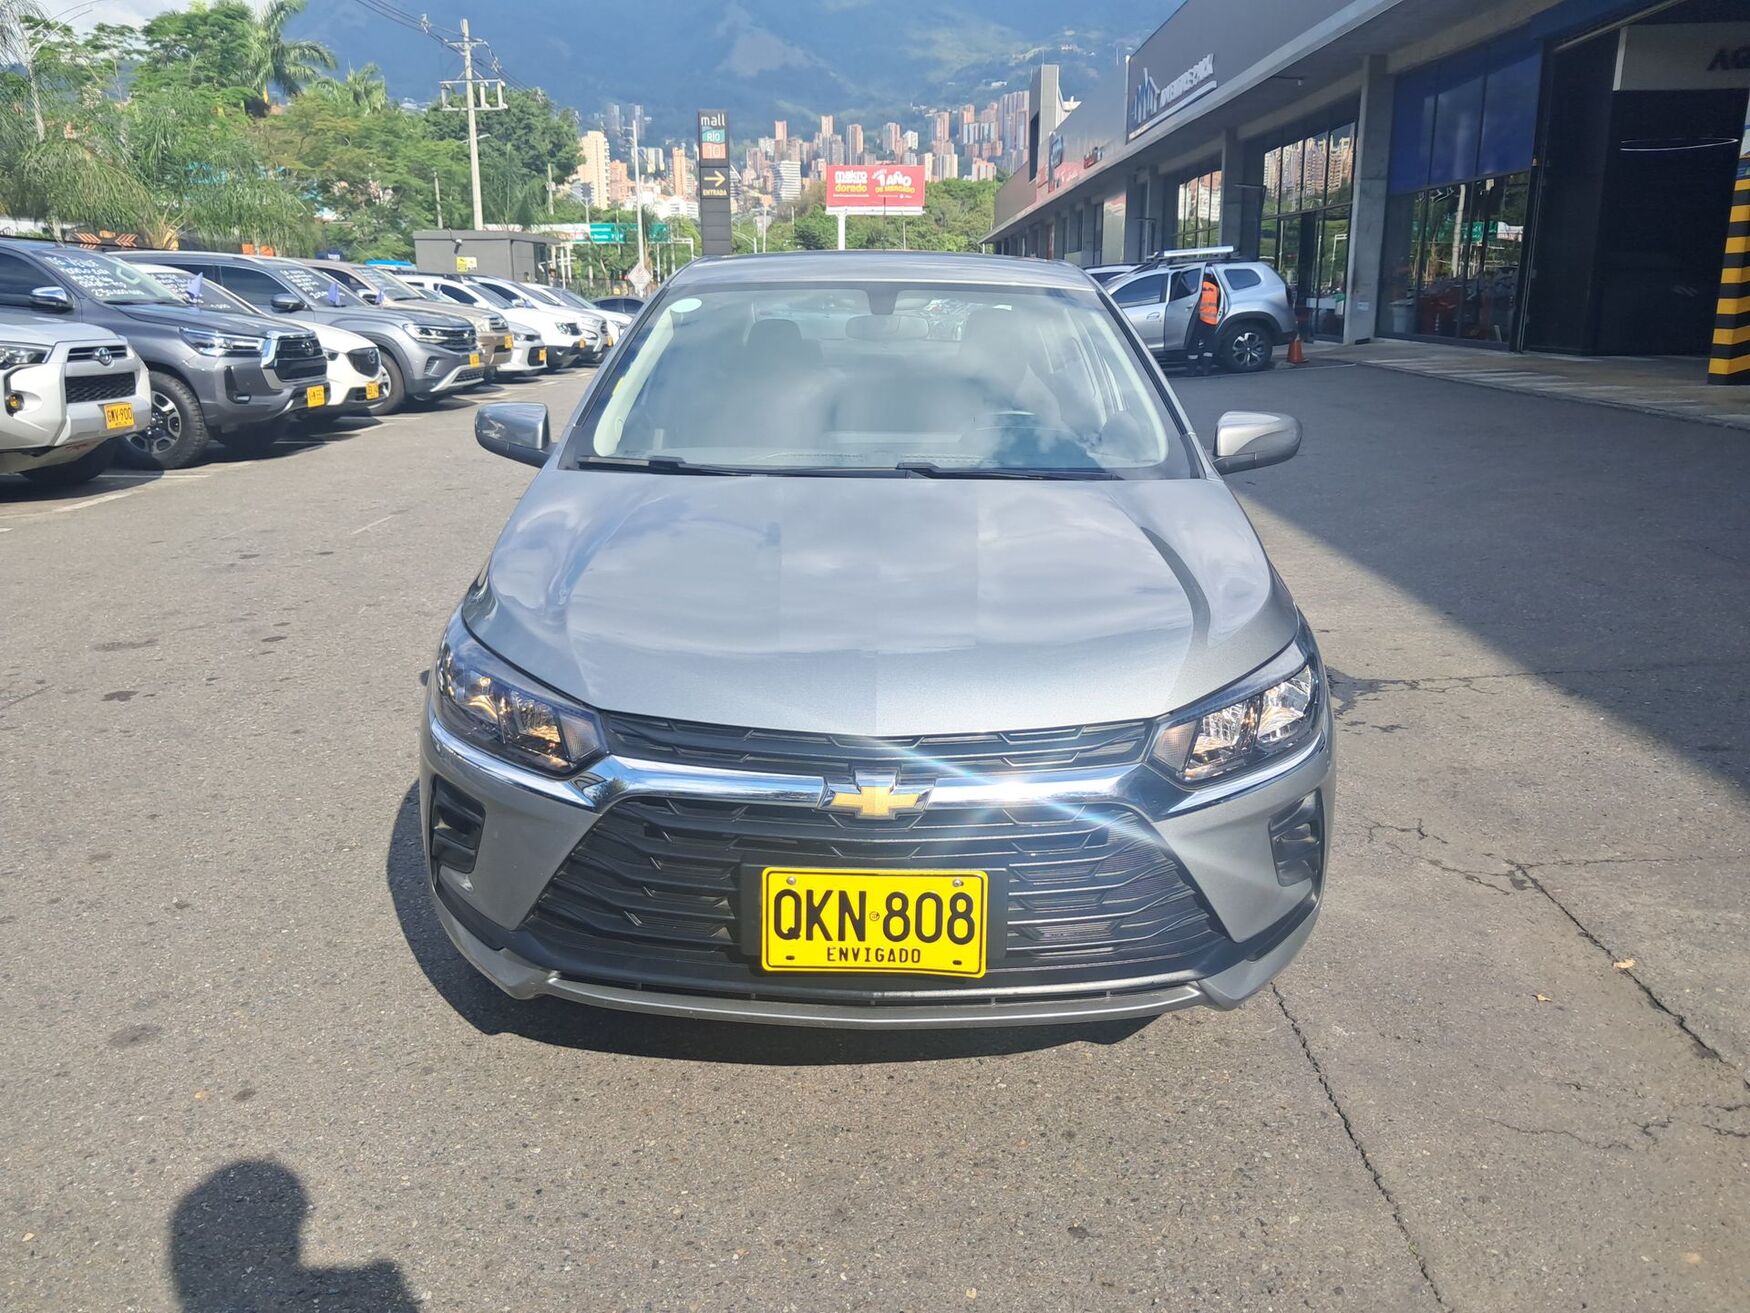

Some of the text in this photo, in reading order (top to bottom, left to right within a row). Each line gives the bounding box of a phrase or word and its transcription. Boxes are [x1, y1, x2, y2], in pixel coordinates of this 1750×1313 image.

[701, 112, 725, 126] mall
[886, 171, 912, 187] AÑO
[835, 183, 867, 192] dorado
[774, 889, 976, 945] QKN 808
[827, 946, 921, 963] ENVIGADO
